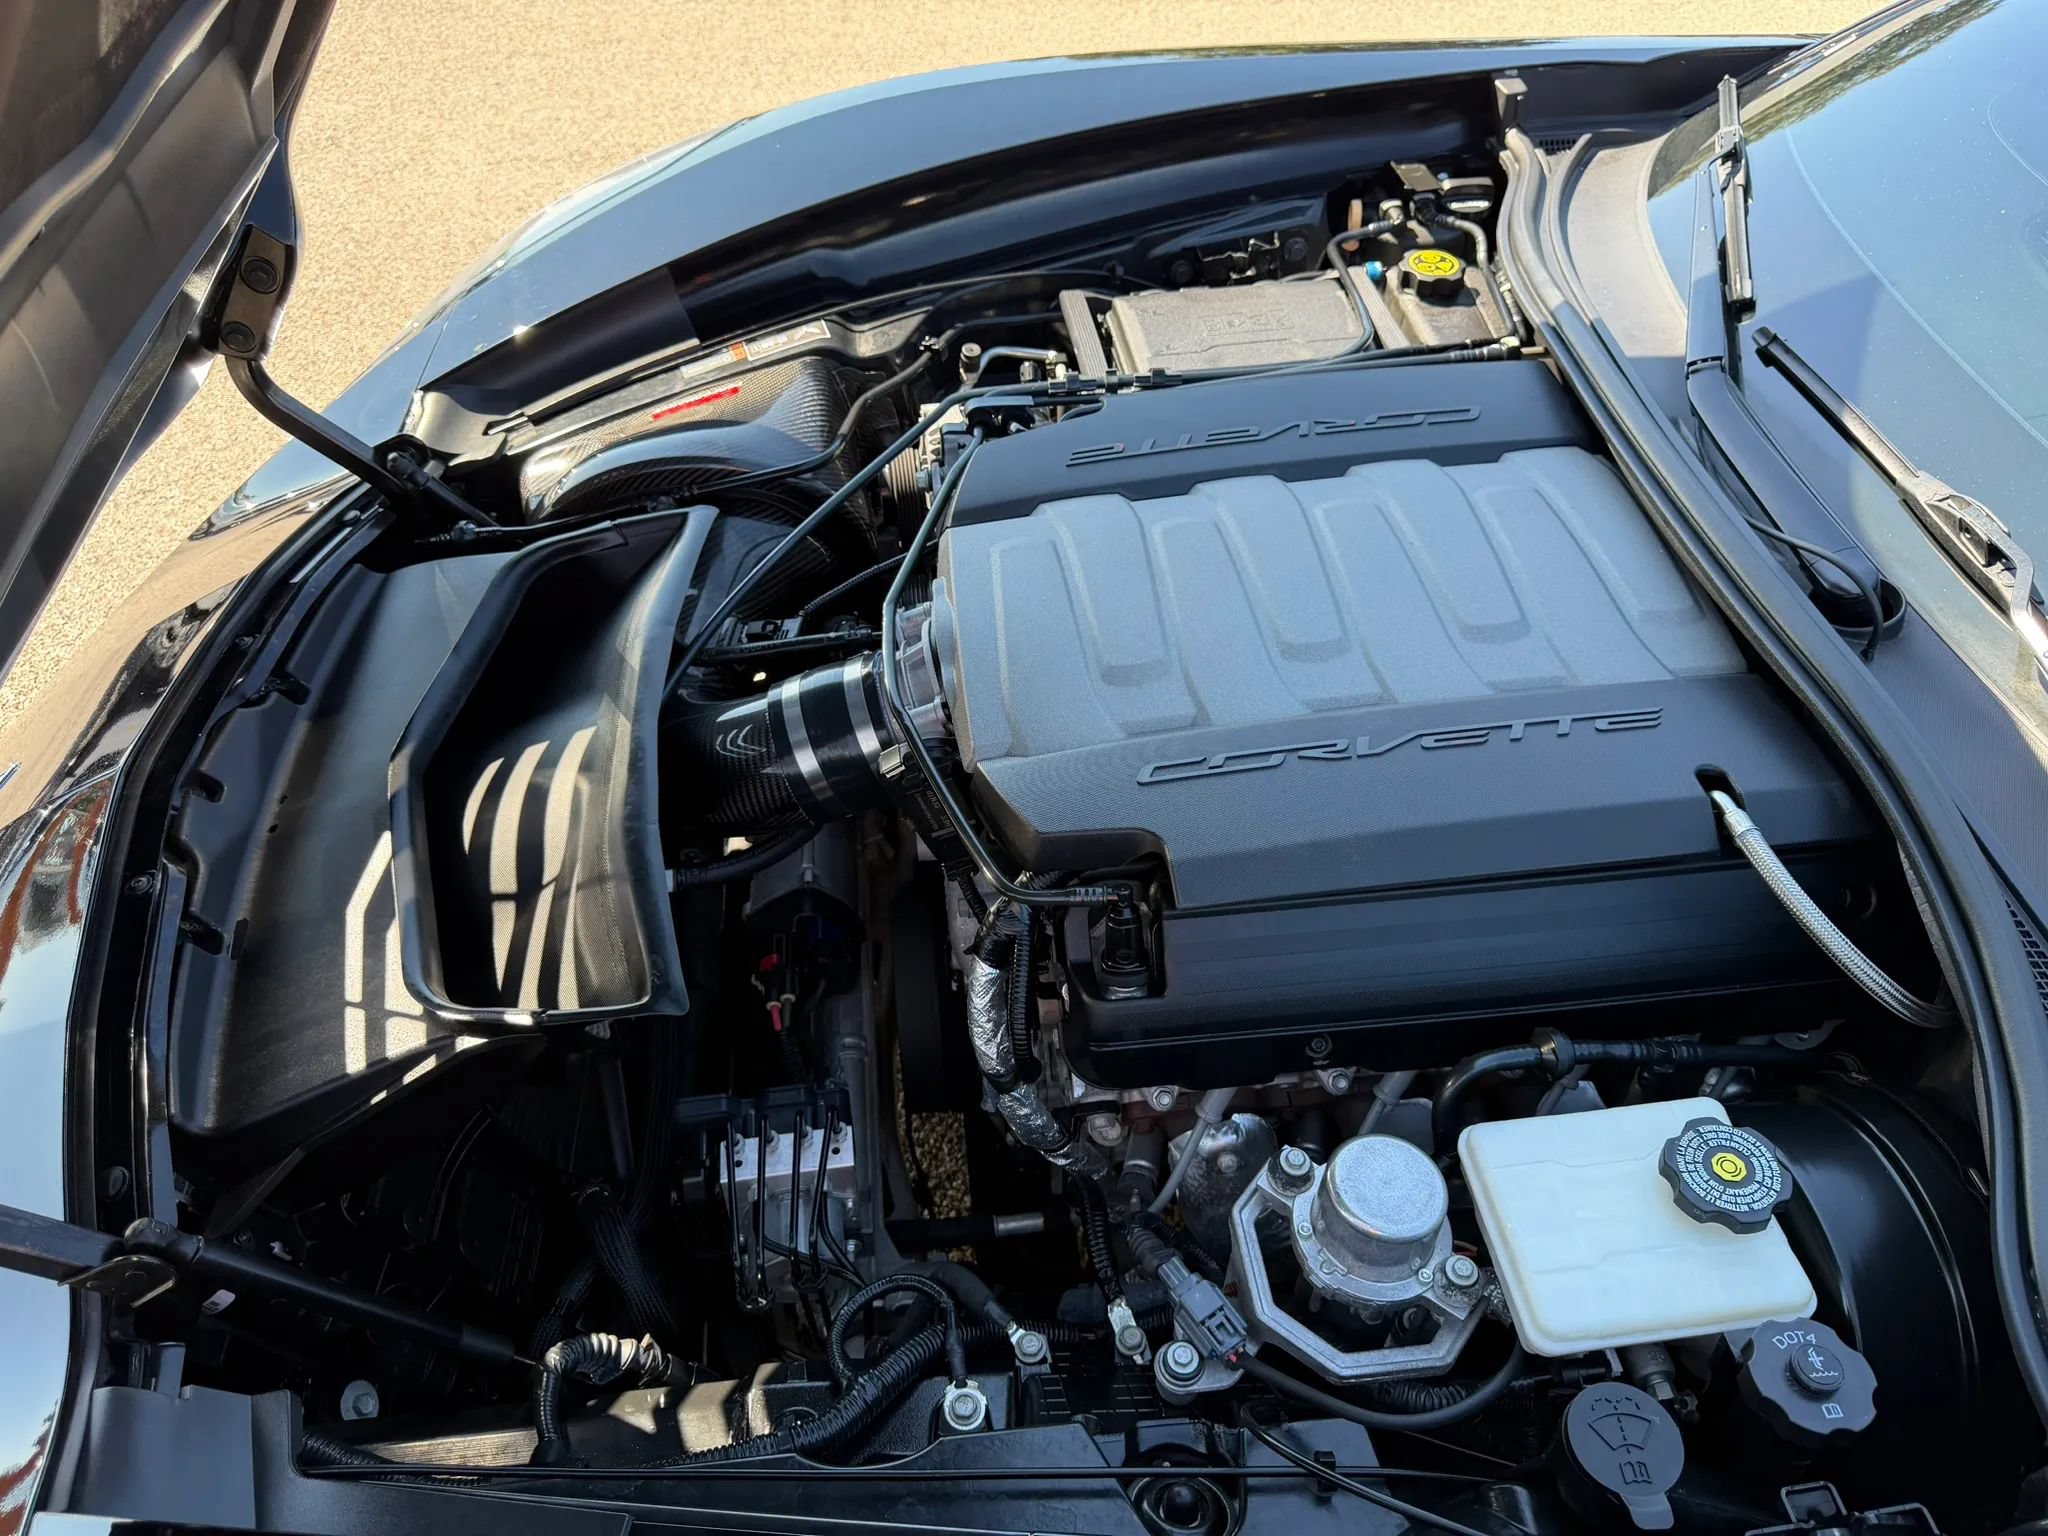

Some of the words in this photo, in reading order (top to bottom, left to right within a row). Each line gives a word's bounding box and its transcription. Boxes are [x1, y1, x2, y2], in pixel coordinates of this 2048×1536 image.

[1066, 405, 1482, 467] CORVETTE
[1136, 706, 1663, 785] CORVETTE
[1700, 1131, 1718, 1141] ONLY
[1706, 1138, 1729, 1147] FILLER
[1716, 1131, 1730, 1139] USE
[1733, 1127, 1757, 1144] SEALED
[1685, 1145, 1695, 1162] FREIN
[1730, 1140, 1752, 1156] CLEAN
[1676, 1154, 1687, 1172] AVANT
[1695, 1162, 1710, 1181] BIDON
[1757, 1155, 1772, 1177] BEFORE
[1680, 1171, 1707, 1198] BOUCHON
[1689, 1171, 1711, 1193] LIQUIDE
[1714, 1198, 1750, 1211] NETTOYER
[1720, 1193, 1736, 1203] QUE
